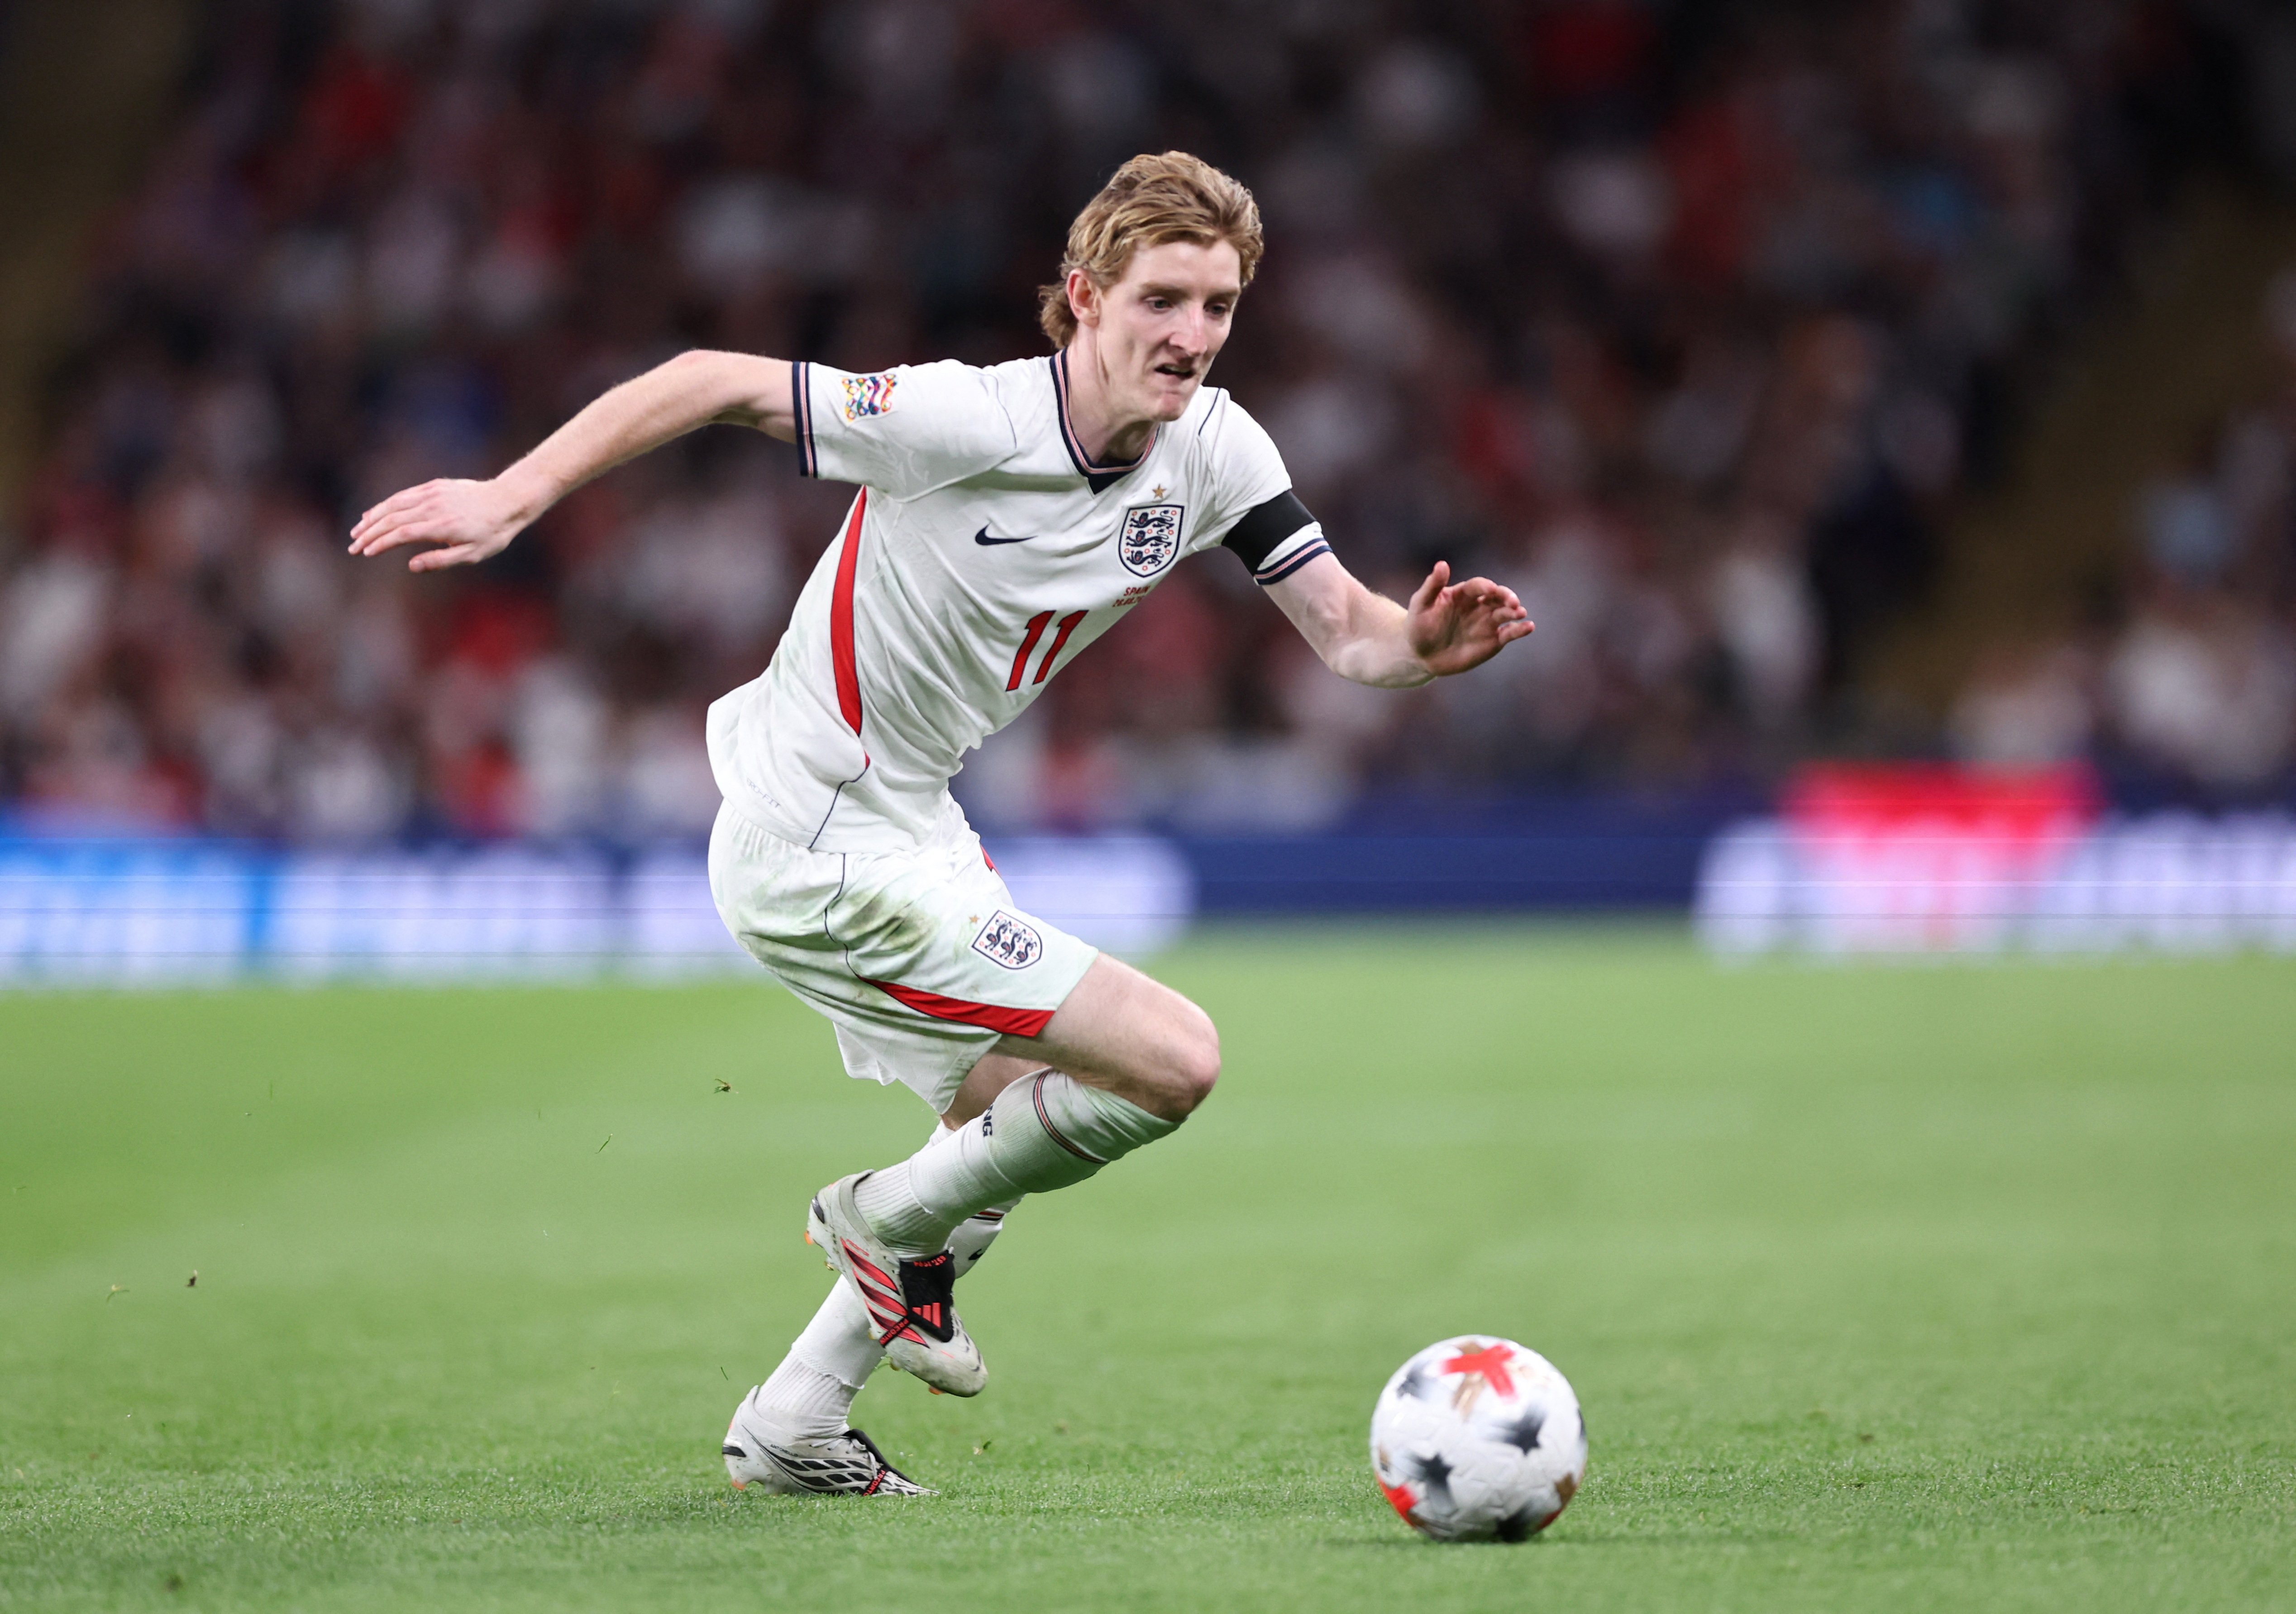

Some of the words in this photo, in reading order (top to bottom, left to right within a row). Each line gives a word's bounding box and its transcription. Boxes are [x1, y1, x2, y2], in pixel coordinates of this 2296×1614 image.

[1005, 609, 1089, 692] 11
[746, 777, 782, 808] ERO-FIT
[982, 1104, 993, 1137] NG
